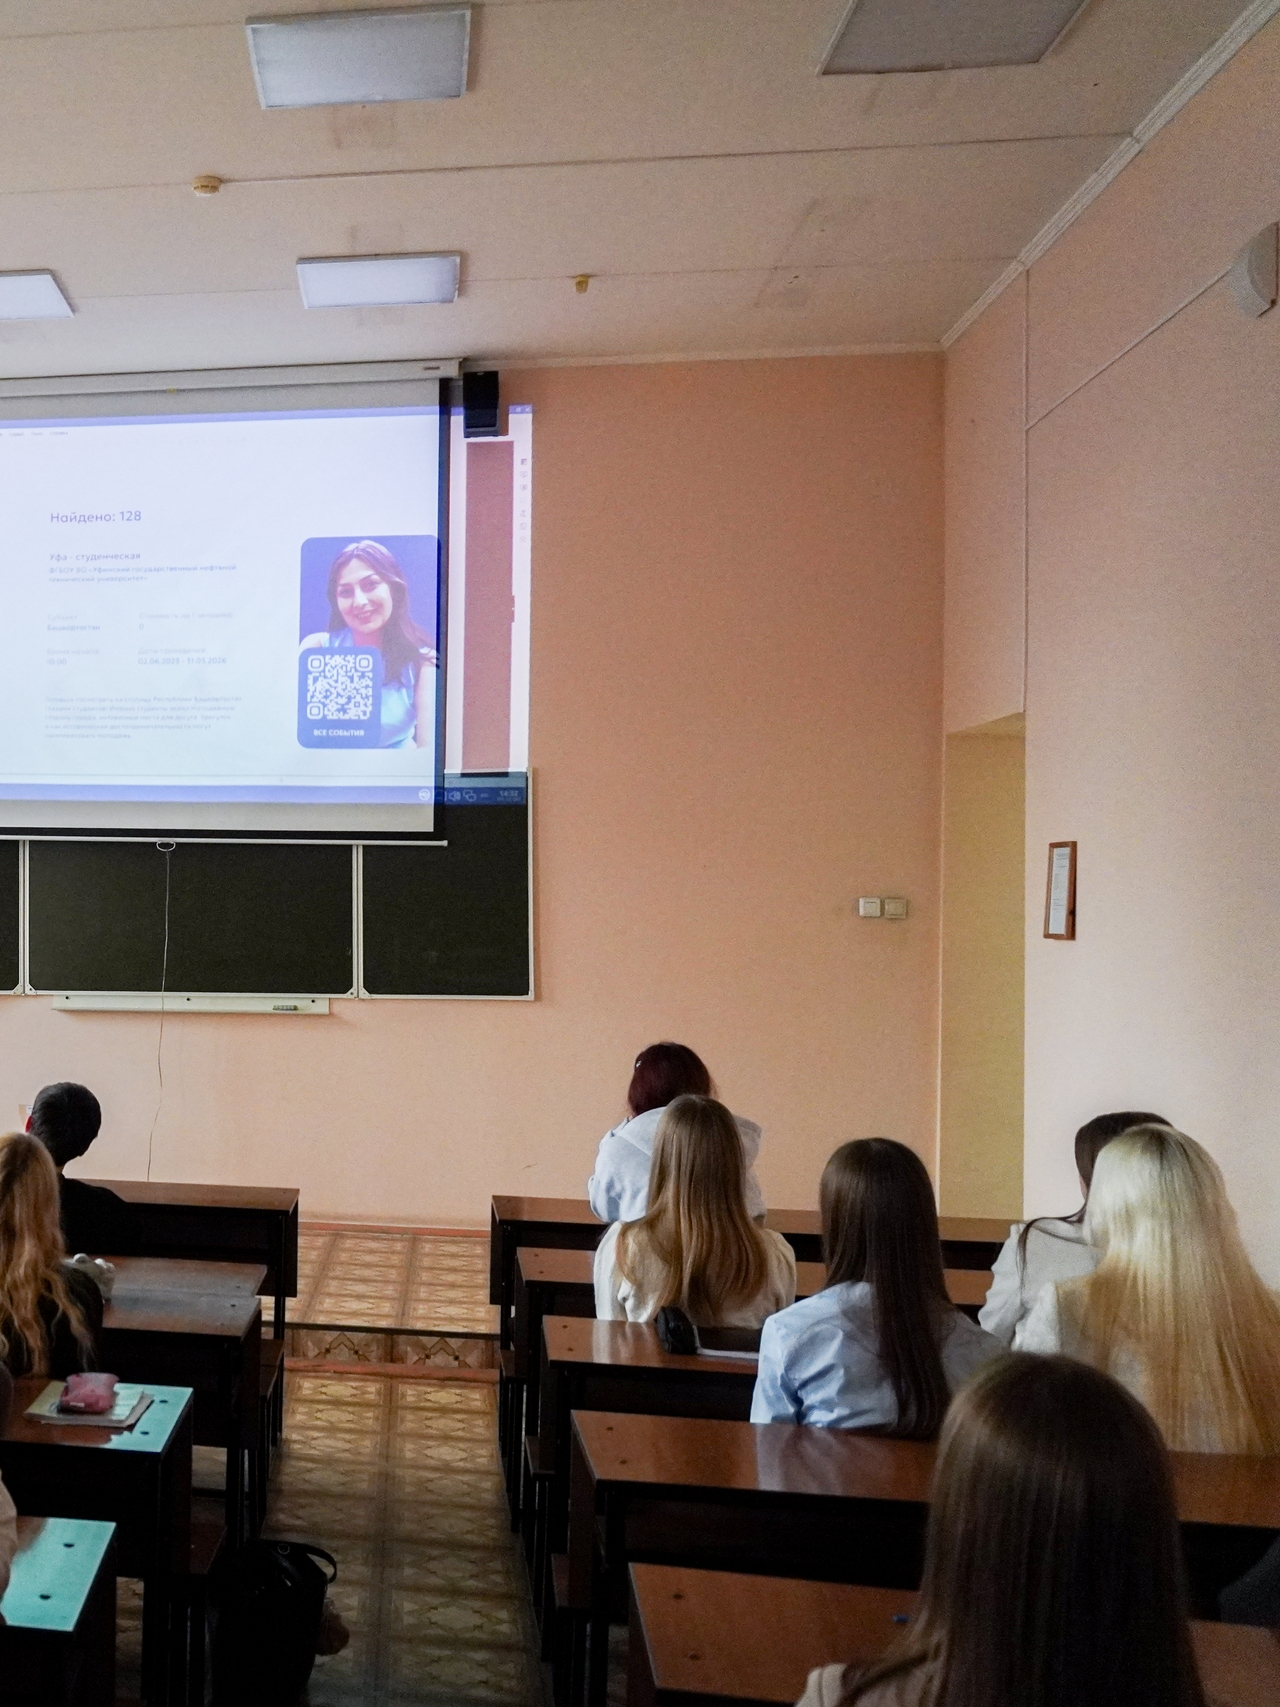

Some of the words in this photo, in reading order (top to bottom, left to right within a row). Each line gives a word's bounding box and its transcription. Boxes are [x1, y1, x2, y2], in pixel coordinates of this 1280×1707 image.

[50, 511, 116, 524] Найдено:
[119, 510, 142, 522] 128
[49, 553, 68, 563] Уфа
[75, 552, 141, 563] студенческая
[313, 728, 327, 736] ВСЕ
